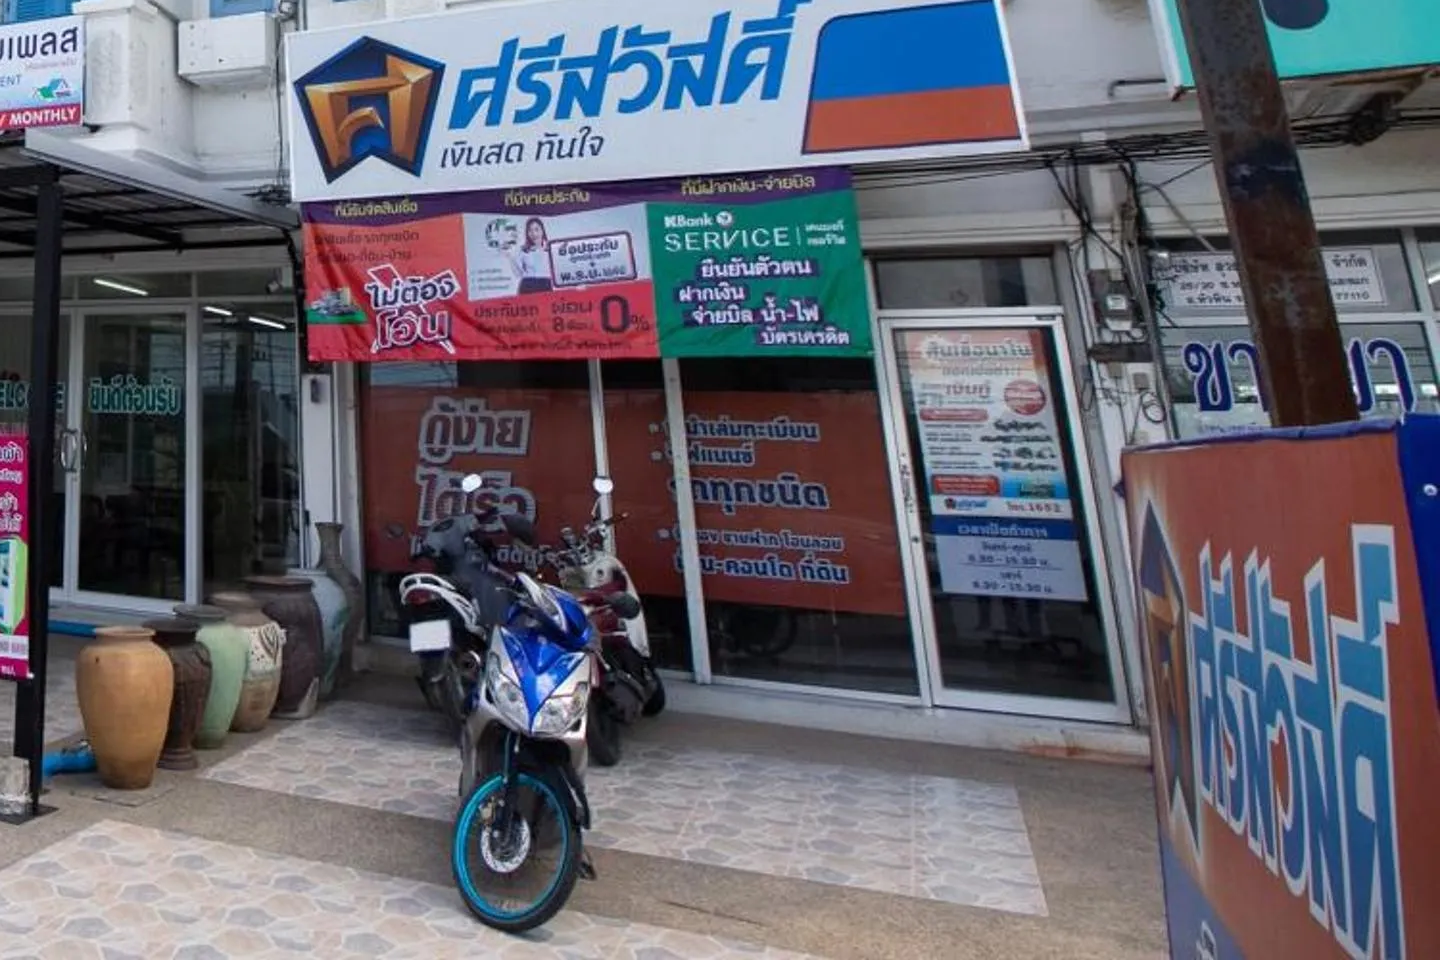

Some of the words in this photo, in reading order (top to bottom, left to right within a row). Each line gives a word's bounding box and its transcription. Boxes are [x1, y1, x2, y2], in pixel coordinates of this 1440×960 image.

[9, 107, 78, 127] MONTHLY
[439, 135, 524, 171] เงินสด
[534, 127, 605, 165] ทันใจ
[664, 213, 713, 229] KBank
[664, 226, 791, 253] SERVICE
[700, 254, 812, 280] ยืนยันตัวตน
[365, 273, 457, 308] ไม่ต้อง
[678, 280, 745, 303] ฝากเงิน
[691, 304, 754, 325] จ่ายบิล
[760, 296, 820, 324] น้ำ-ไฟ
[760, 326, 850, 346] บัตรเครดิต
[87, 373, 181, 416] ยินดีต้อนรับ
[1182, 337, 1416, 423] ขาา
[421, 398, 529, 462] กู้ง่าย
[668, 472, 829, 514] ถทุกชนิด
[1190, 523, 1406, 960] ศรีสวัสดิ์
